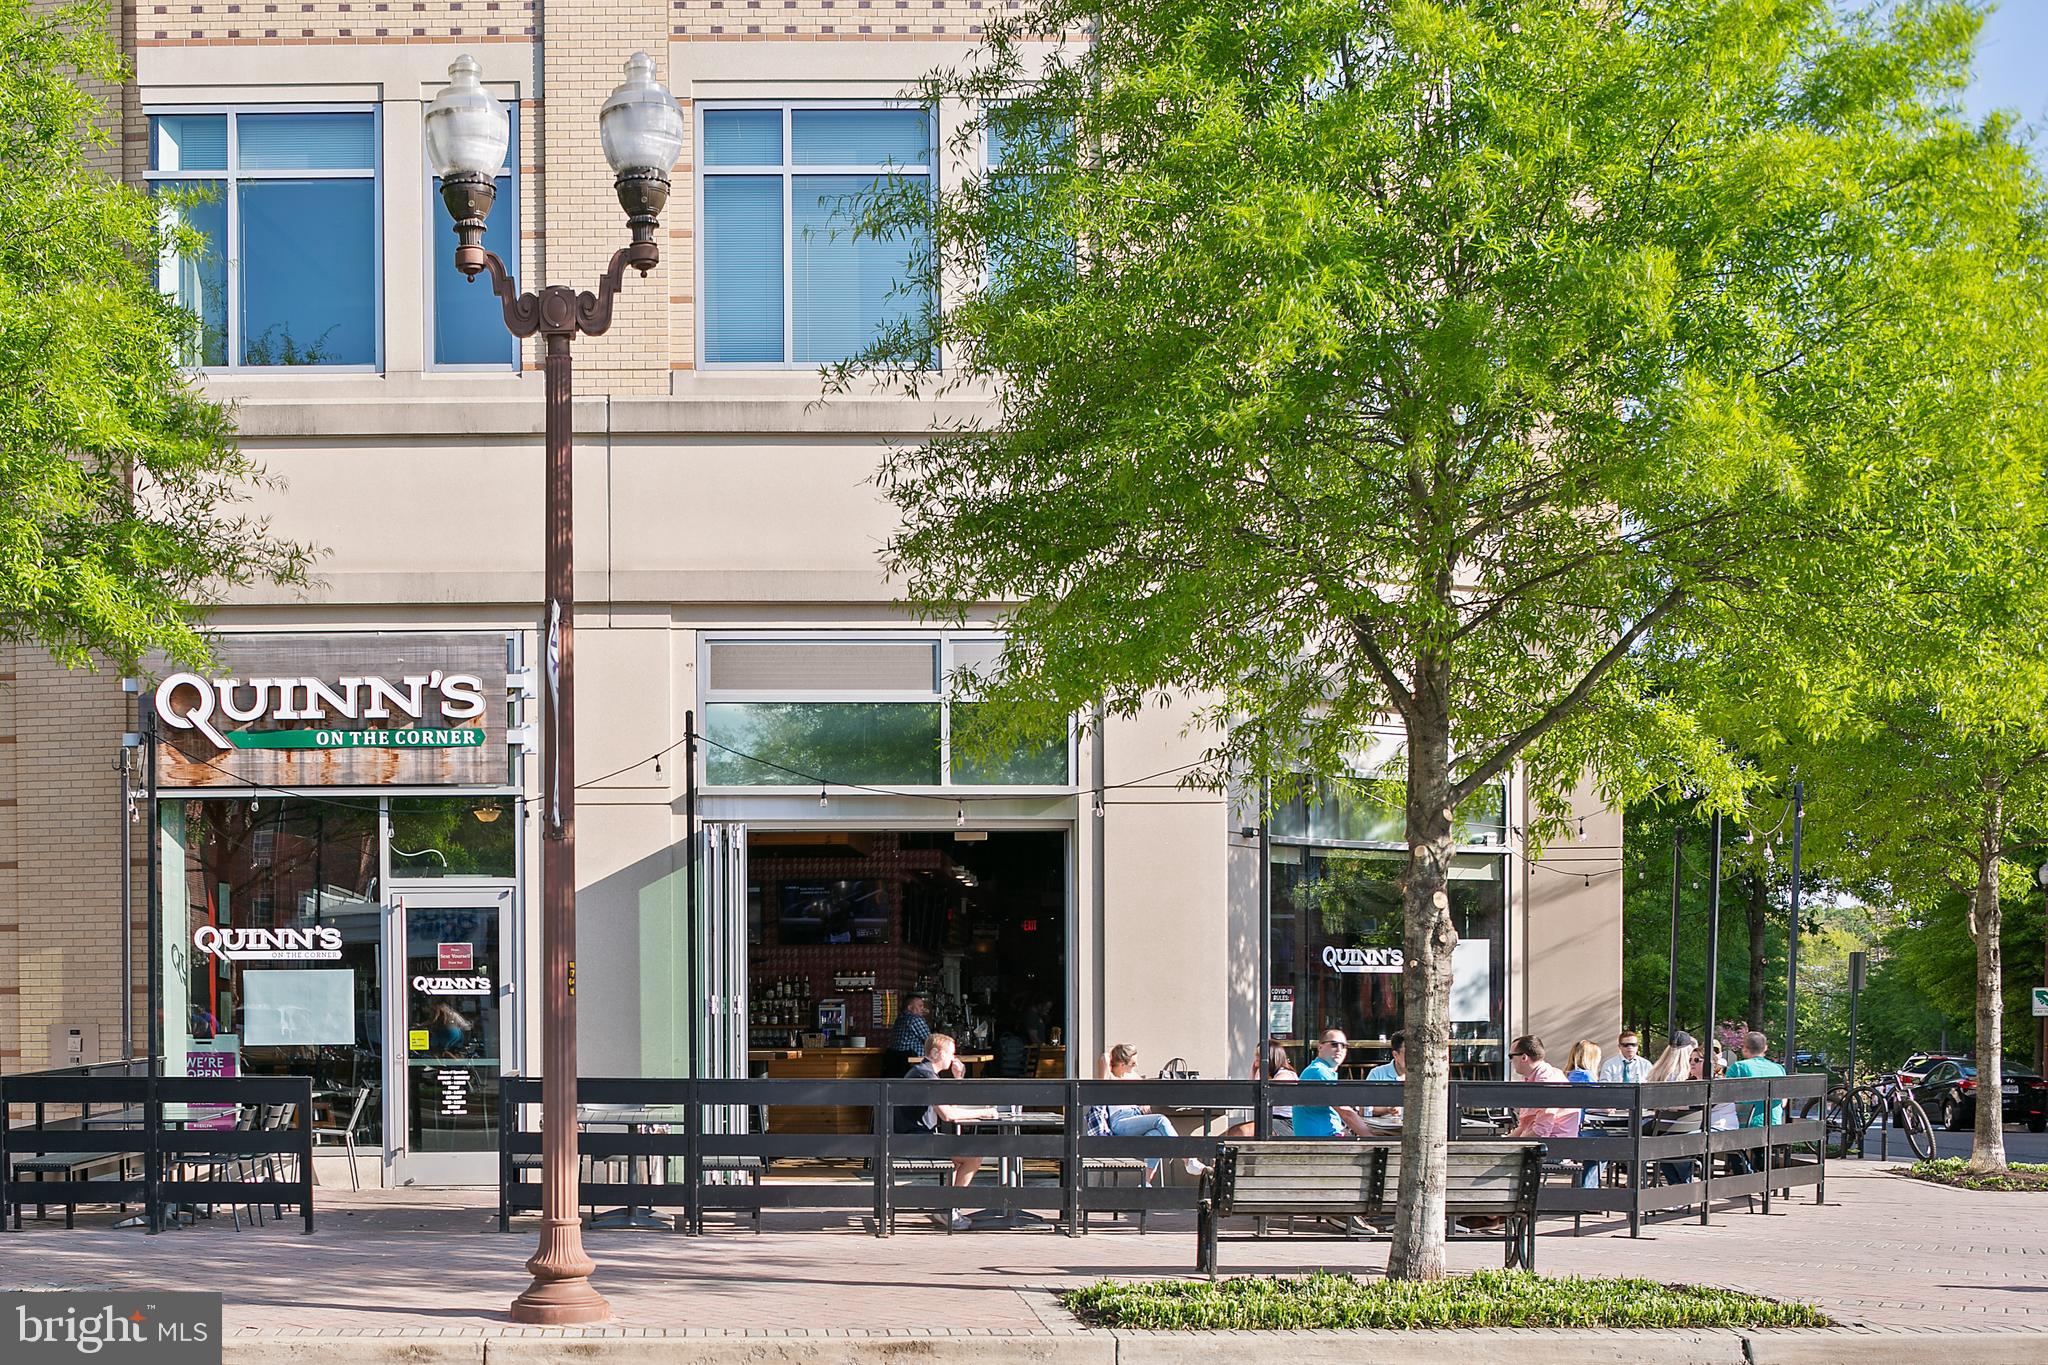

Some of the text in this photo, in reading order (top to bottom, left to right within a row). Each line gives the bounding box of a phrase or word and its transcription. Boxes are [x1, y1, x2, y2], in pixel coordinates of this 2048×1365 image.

[155, 669, 486, 749] QUINN'S
[316, 729, 476, 745] ON THE CORNER
[194, 925, 343, 960] QUINN'S
[1323, 945, 1404, 973] QUINN'S
[413, 976, 491, 995] QUINN'S
[187, 1057, 224, 1068] WE'RE
